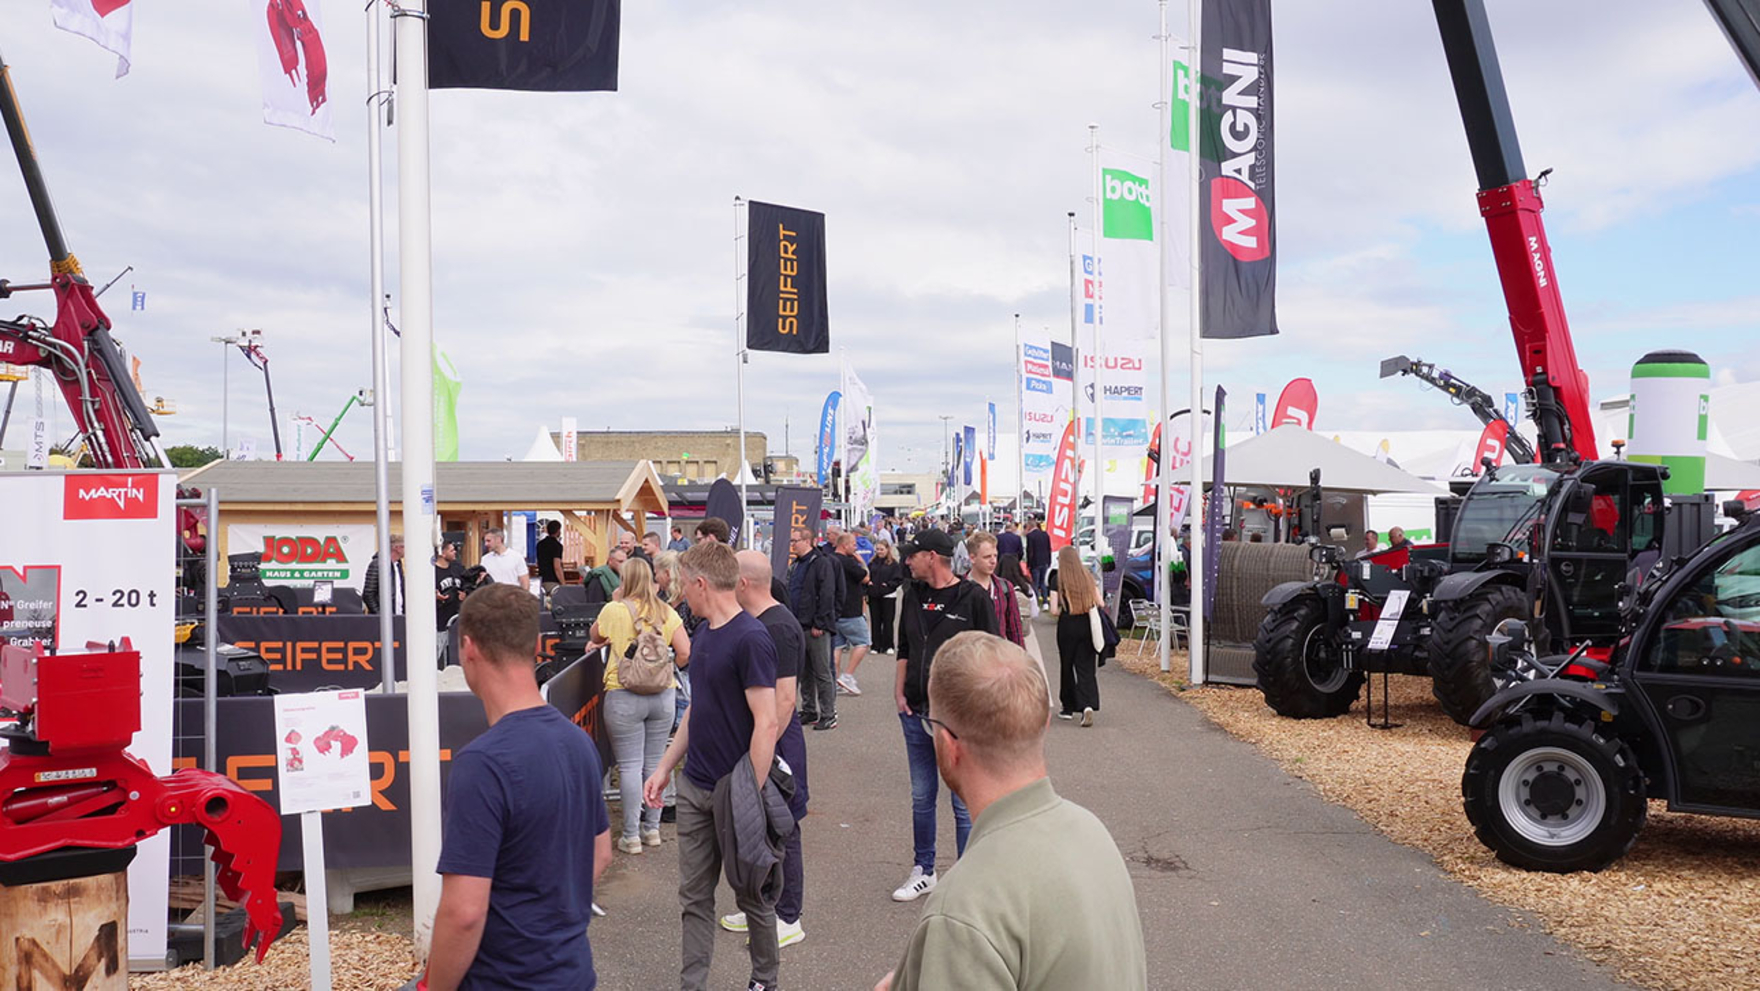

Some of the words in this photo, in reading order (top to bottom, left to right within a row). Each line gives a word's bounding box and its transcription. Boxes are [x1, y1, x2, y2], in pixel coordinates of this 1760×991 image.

[1220, 48, 1258, 249] MAGNI
[1106, 175, 1150, 207] bott
[1528, 236, 1548, 288] MAGNI
[778, 223, 798, 335] SEIFERT
[1025, 412, 1053, 423] ISUZU
[78, 477, 144, 510] MARTIN
[262, 536, 349, 564] JODA
[17, 600, 53, 609] Greifer
[75, 590, 88, 608] 2
[111, 589, 140, 608] 20
[148, 590, 157, 607] t
